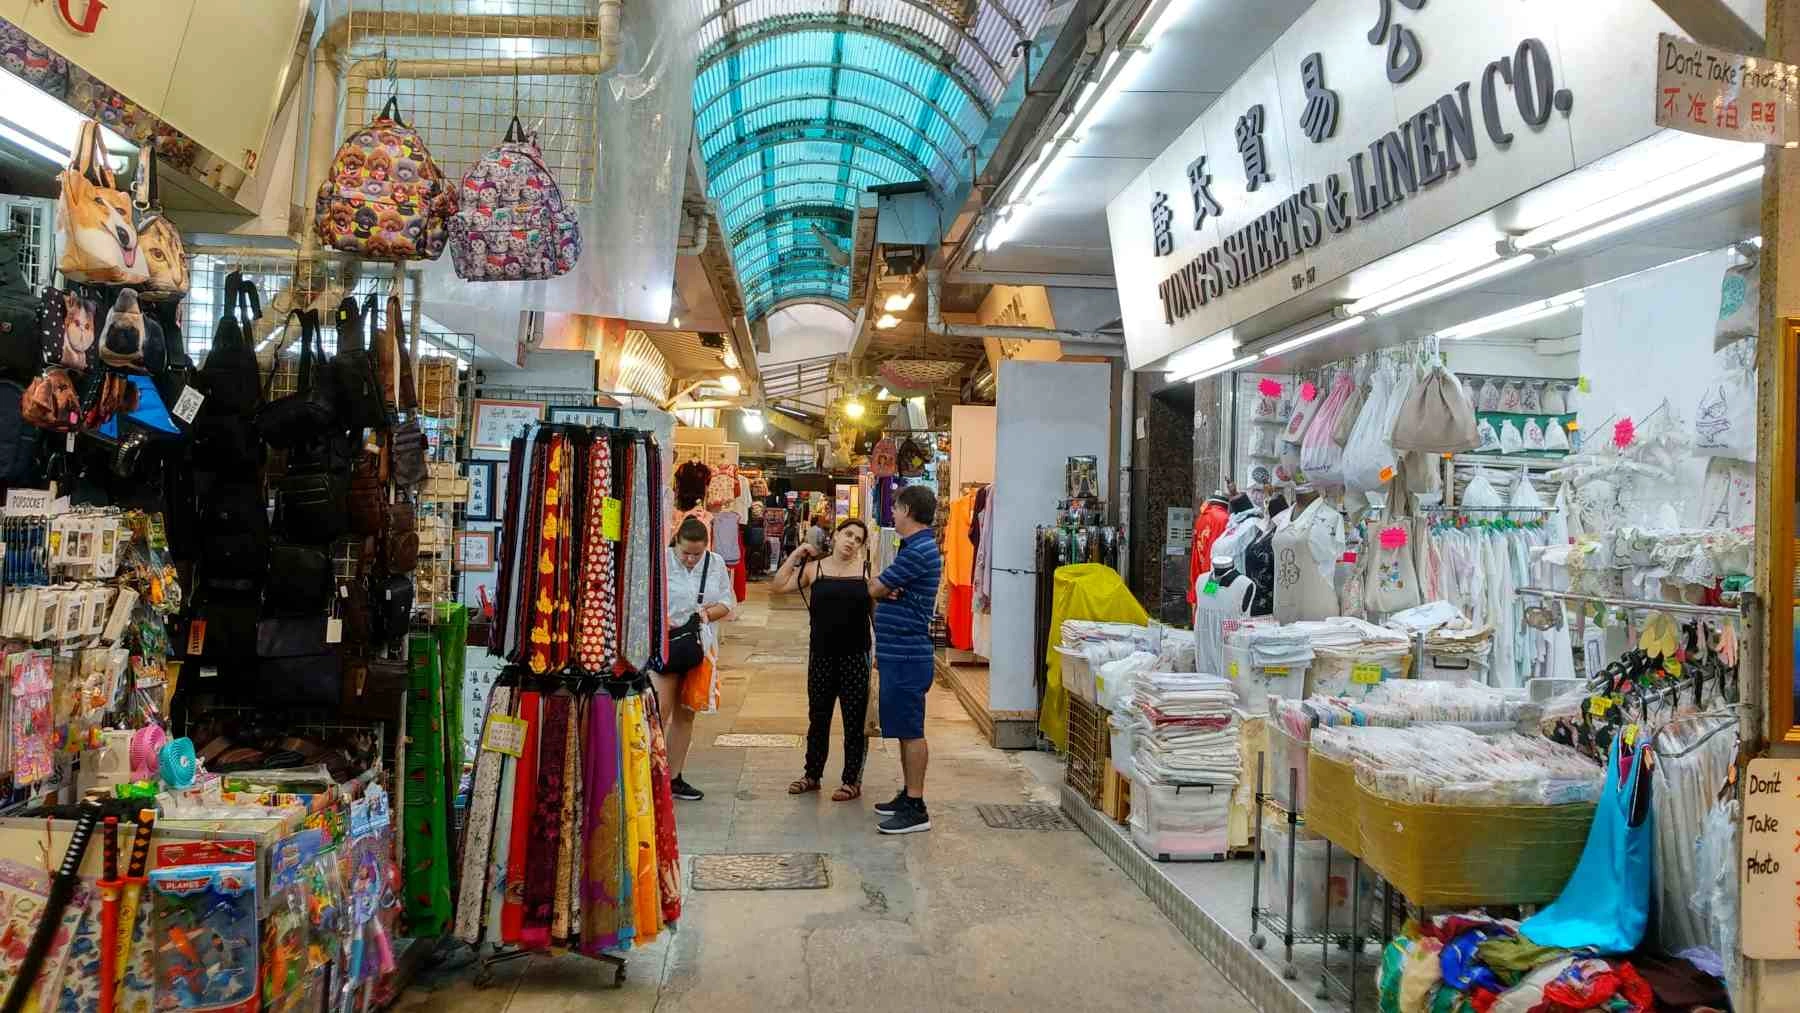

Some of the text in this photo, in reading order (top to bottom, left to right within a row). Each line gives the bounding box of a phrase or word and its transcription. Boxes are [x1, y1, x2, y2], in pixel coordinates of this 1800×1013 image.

[1665, 41, 1703, 79] Don't
[1706, 55, 1738, 86] Take
[1663, 87, 1778, 136] 不准拍照
[1158, 38, 1574, 326] TONG'S SHEETS & LINEN CO.
[1750, 768, 1781, 795] Don't
[1747, 813, 1779, 833] Take
